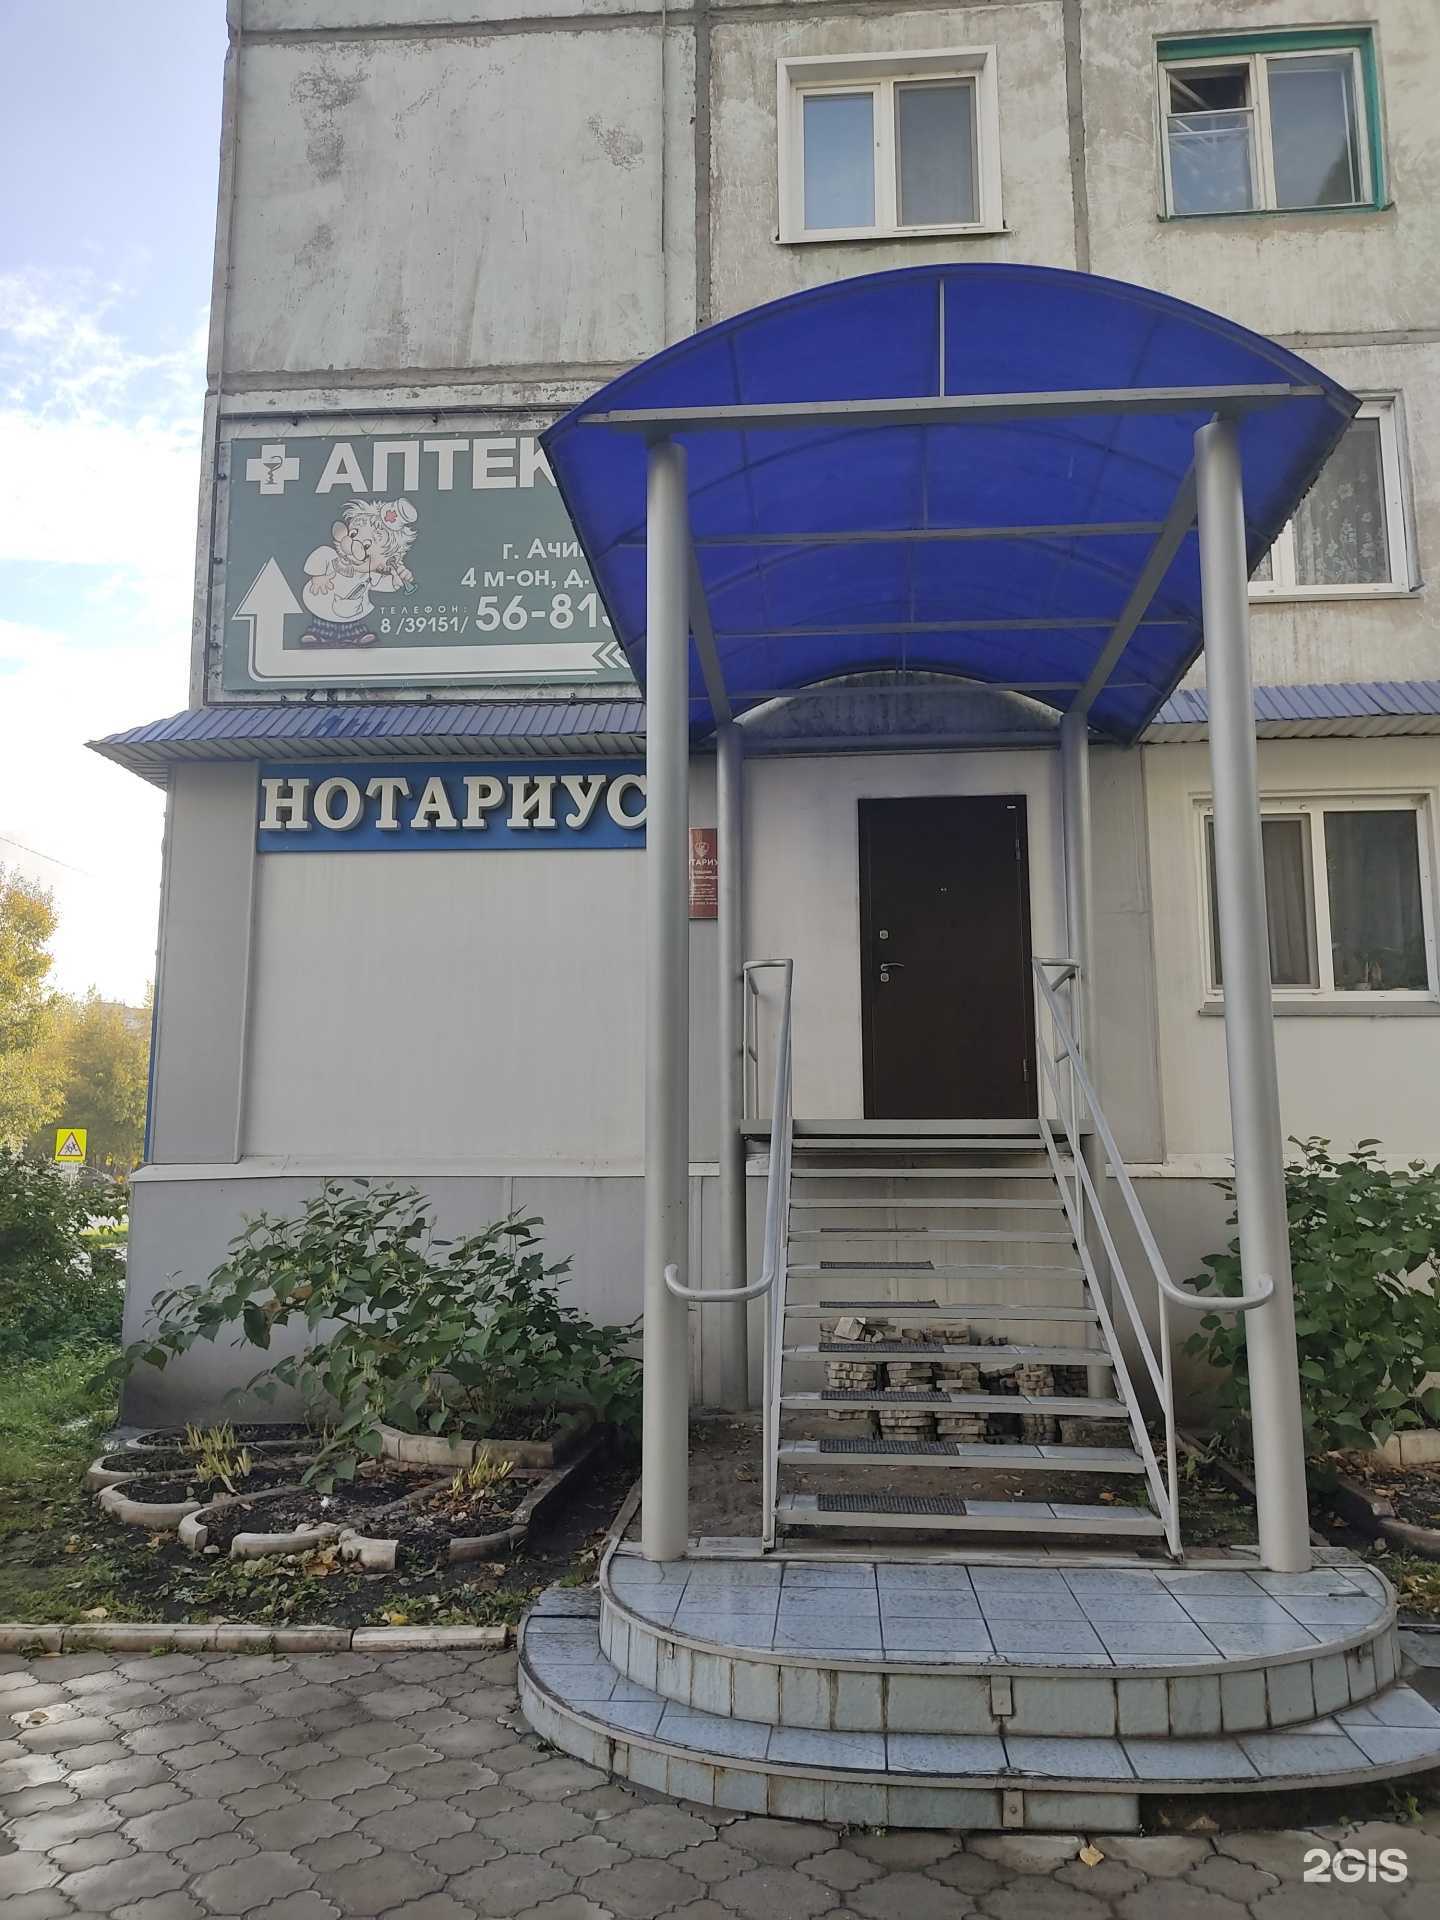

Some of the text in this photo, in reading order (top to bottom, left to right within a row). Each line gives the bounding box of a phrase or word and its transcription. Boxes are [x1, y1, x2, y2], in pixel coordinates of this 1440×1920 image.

[315, 437, 557, 493] АПТЕК
[502, 538, 584, 560] г. Ачи
[461, 567, 477, 587] 4
[380, 592, 612, 635] 8 /39151/ 56-81
[259, 774, 647, 830] НОТАРИУС
